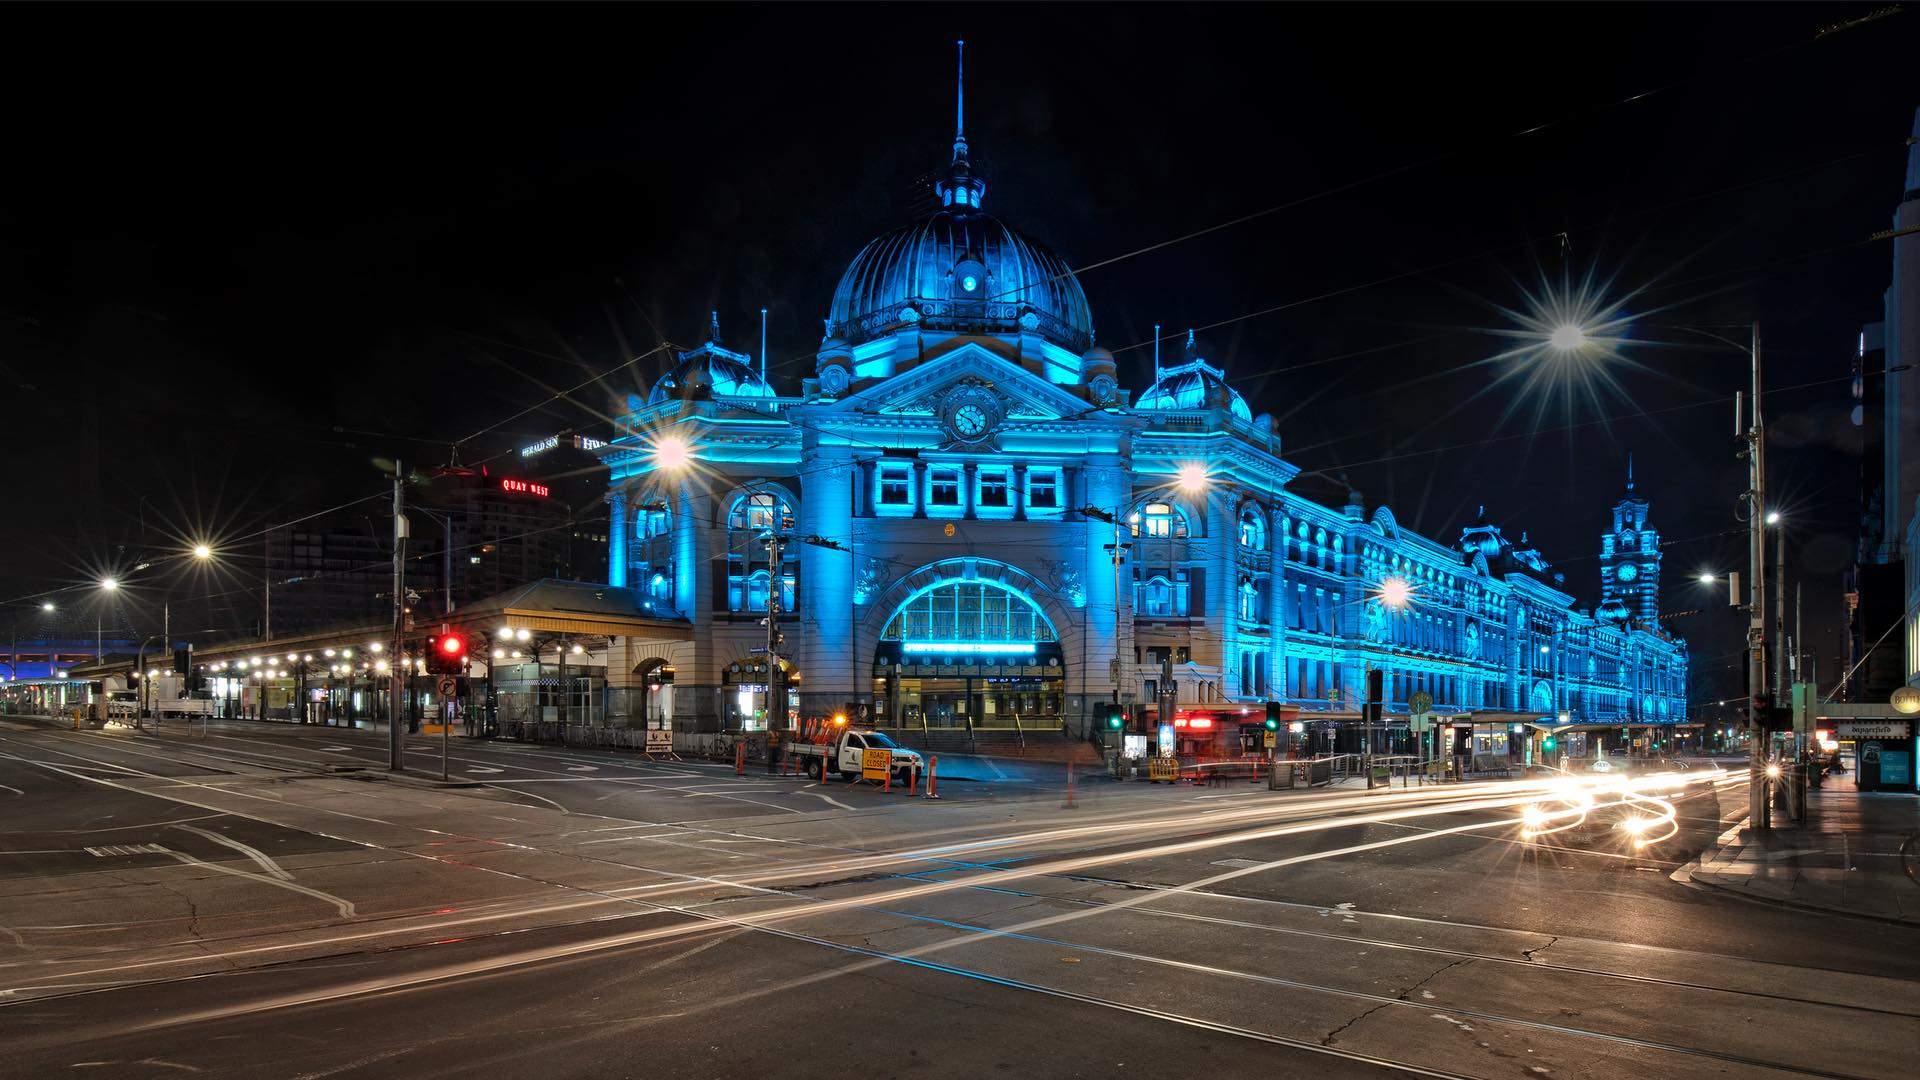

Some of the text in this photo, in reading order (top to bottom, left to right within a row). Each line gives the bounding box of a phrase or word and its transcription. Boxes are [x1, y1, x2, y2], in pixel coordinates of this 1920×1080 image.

[522, 436, 559, 457] HERALD SUN
[503, 480, 549, 497] QUAY WEST
[869, 751, 885, 759] ROAD
[866, 759, 886, 768] CLOSED
